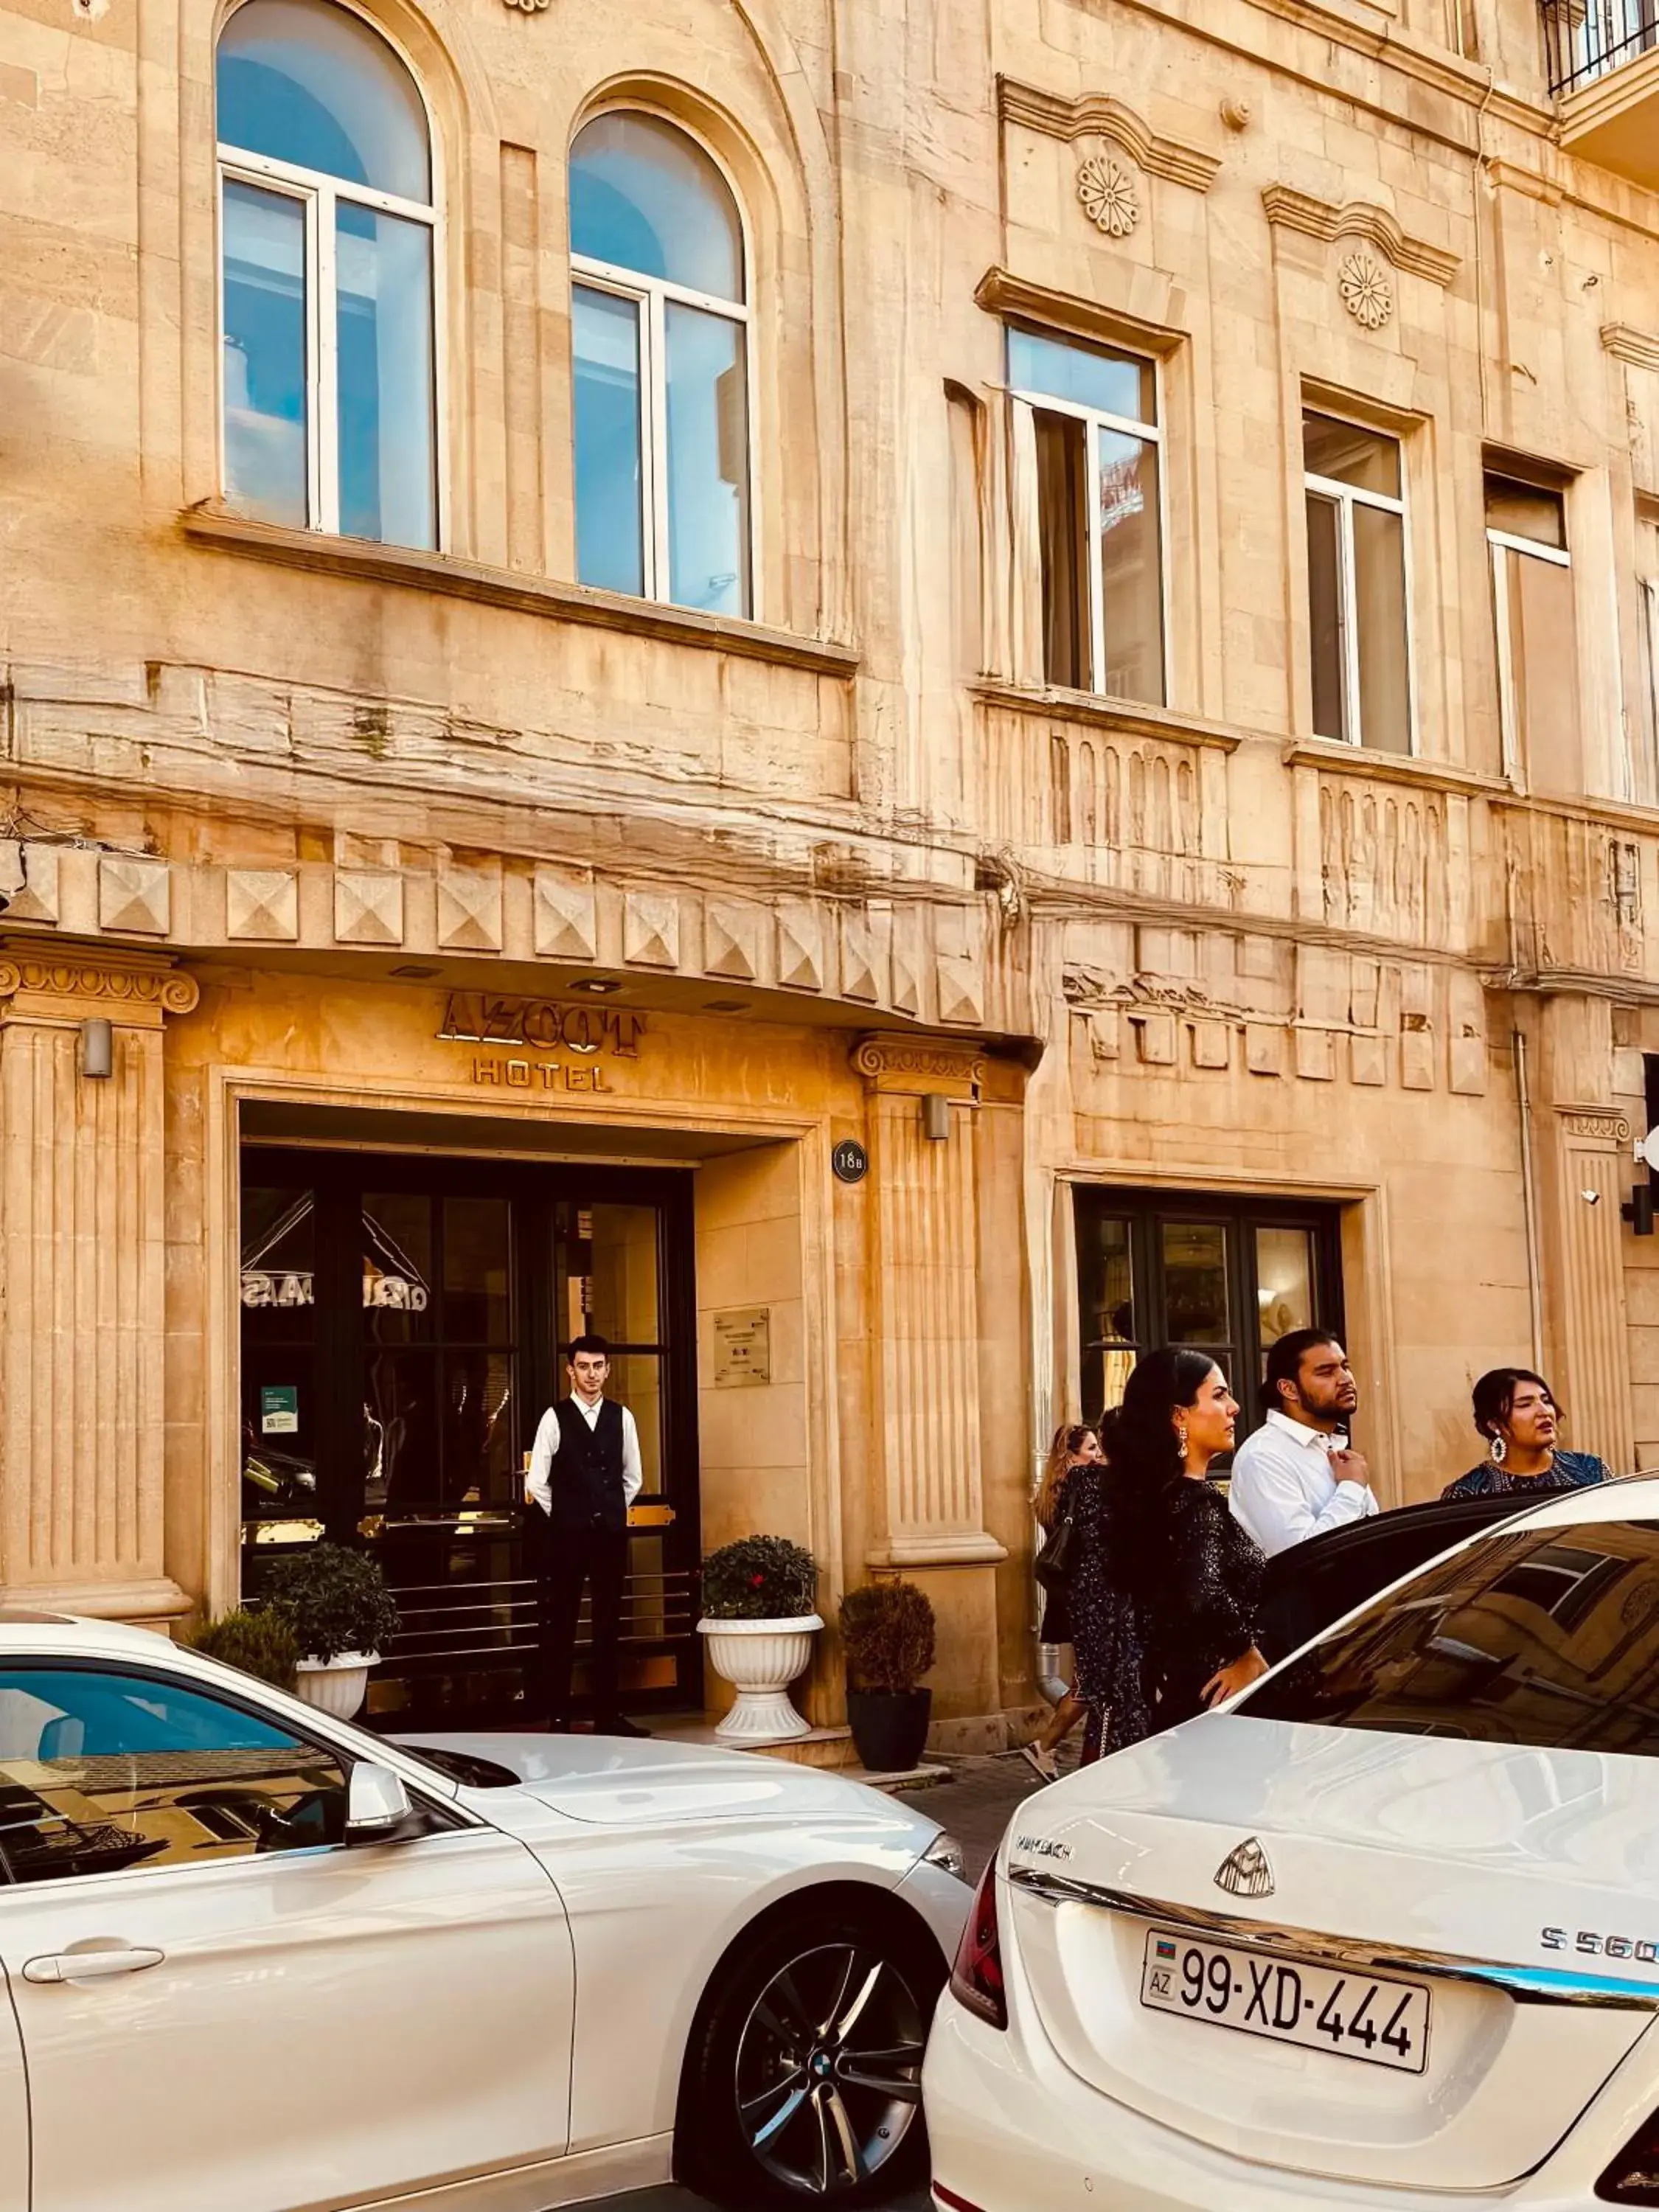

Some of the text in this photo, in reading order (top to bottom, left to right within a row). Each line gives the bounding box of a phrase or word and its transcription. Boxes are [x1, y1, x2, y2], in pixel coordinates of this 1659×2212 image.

[473, 1057, 613, 1093] HOTEL
[1540, 1927, 1659, 1965] S 560
[1149, 1972, 1170, 1995] AZ
[1180, 1948, 1413, 2056] 99-XD-444
